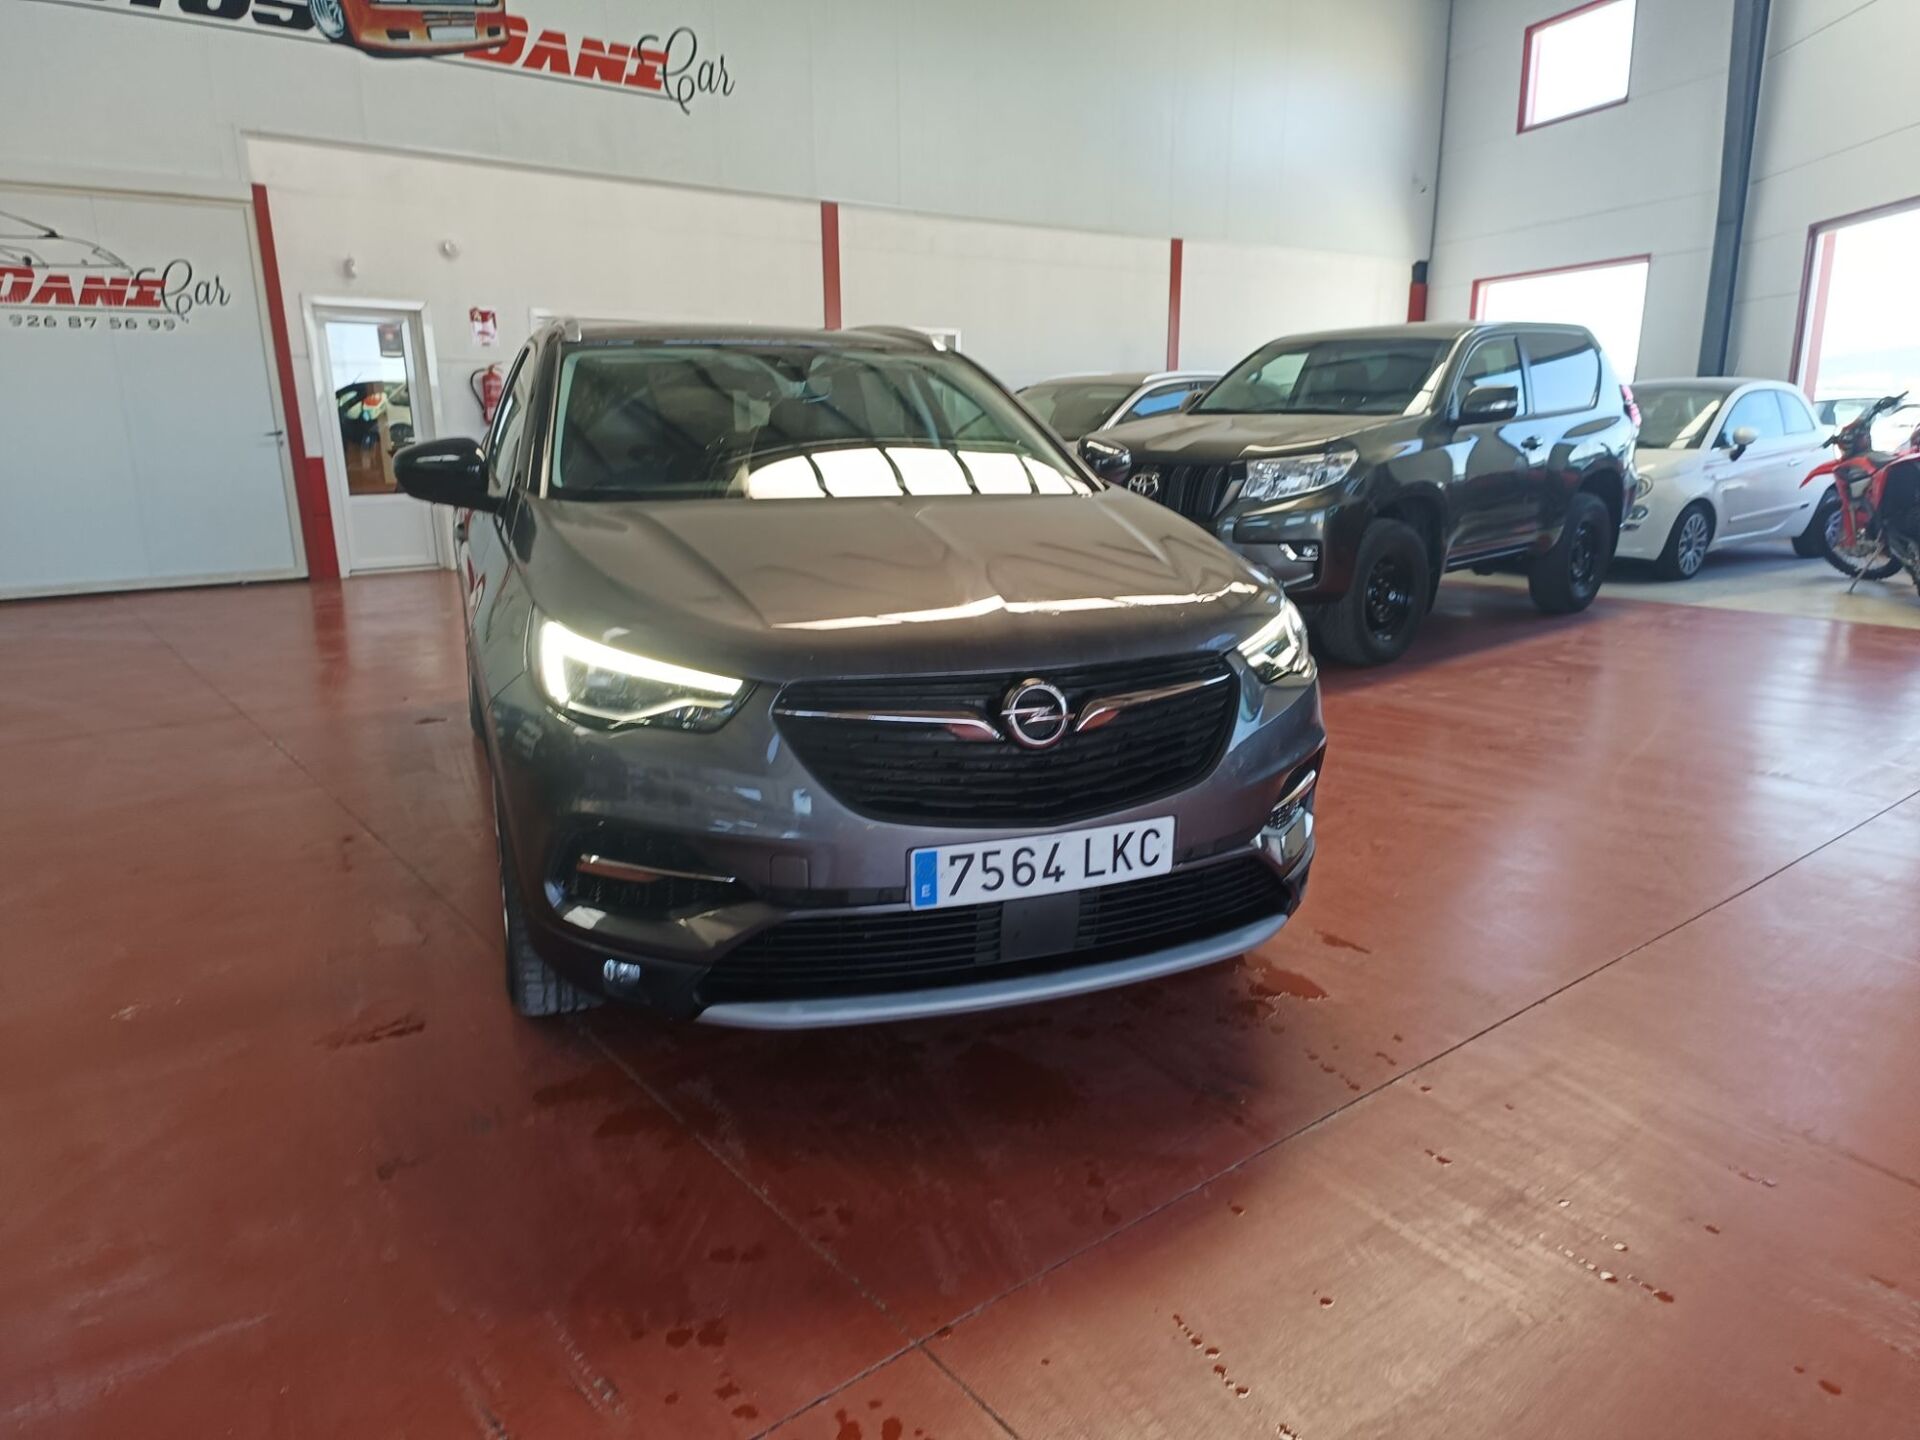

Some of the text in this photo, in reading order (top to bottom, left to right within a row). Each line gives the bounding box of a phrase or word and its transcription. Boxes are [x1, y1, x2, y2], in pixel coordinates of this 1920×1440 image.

[636, 26, 735, 116] Car
[9, 314, 176, 331] 926 87 56 99
[135, 258, 231, 324] Car
[921, 828, 1161, 898] E 7564 LKC
